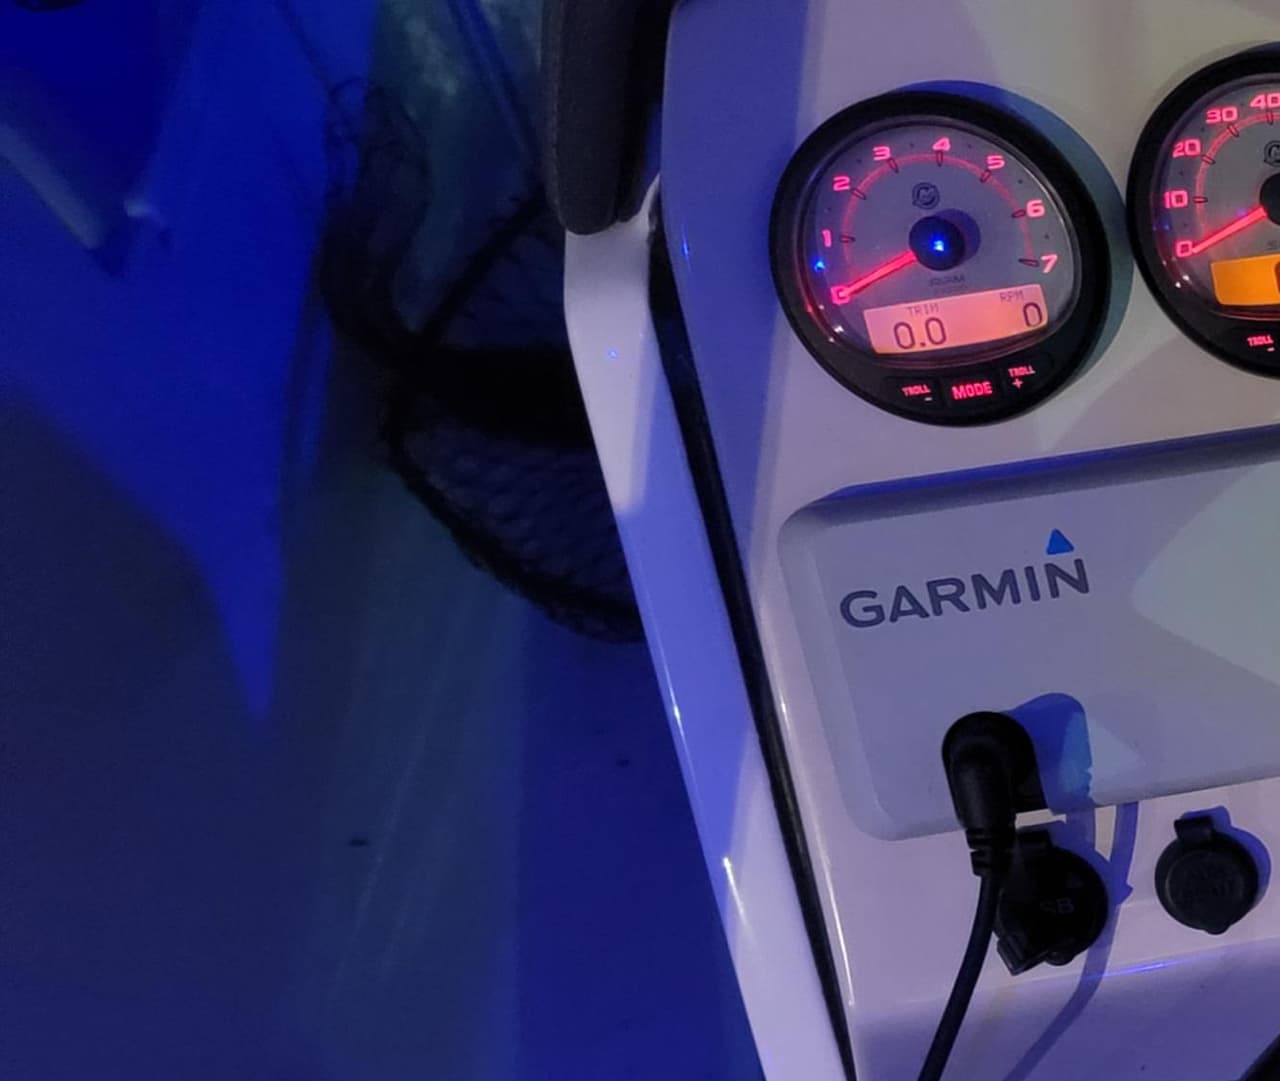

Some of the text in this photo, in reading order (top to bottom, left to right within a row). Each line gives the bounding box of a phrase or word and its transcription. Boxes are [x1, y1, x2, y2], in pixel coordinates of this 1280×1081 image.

[1206, 107, 1238, 124] 30
[932, 137, 951, 151] 4
[1172, 139, 1200, 158] 20
[873, 146, 891, 161] 3
[987, 155, 1005, 170] 5
[833, 176, 850, 191] 2
[1164, 190, 1188, 209] 10
[1026, 200, 1045, 216] 6
[822, 230, 832, 247] 1
[1176, 241, 1193, 257] 0
[1041, 254, 1058, 273] 7
[907, 302, 939, 316] TRIM
[893, 302, 1042, 350] 0.0 0
[1247, 335, 1274, 345] TROLL
[1008, 365, 1035, 377] TROLL
[902, 381, 992, 399] TROLL MODE
[840, 558, 1090, 628] GARMIN
